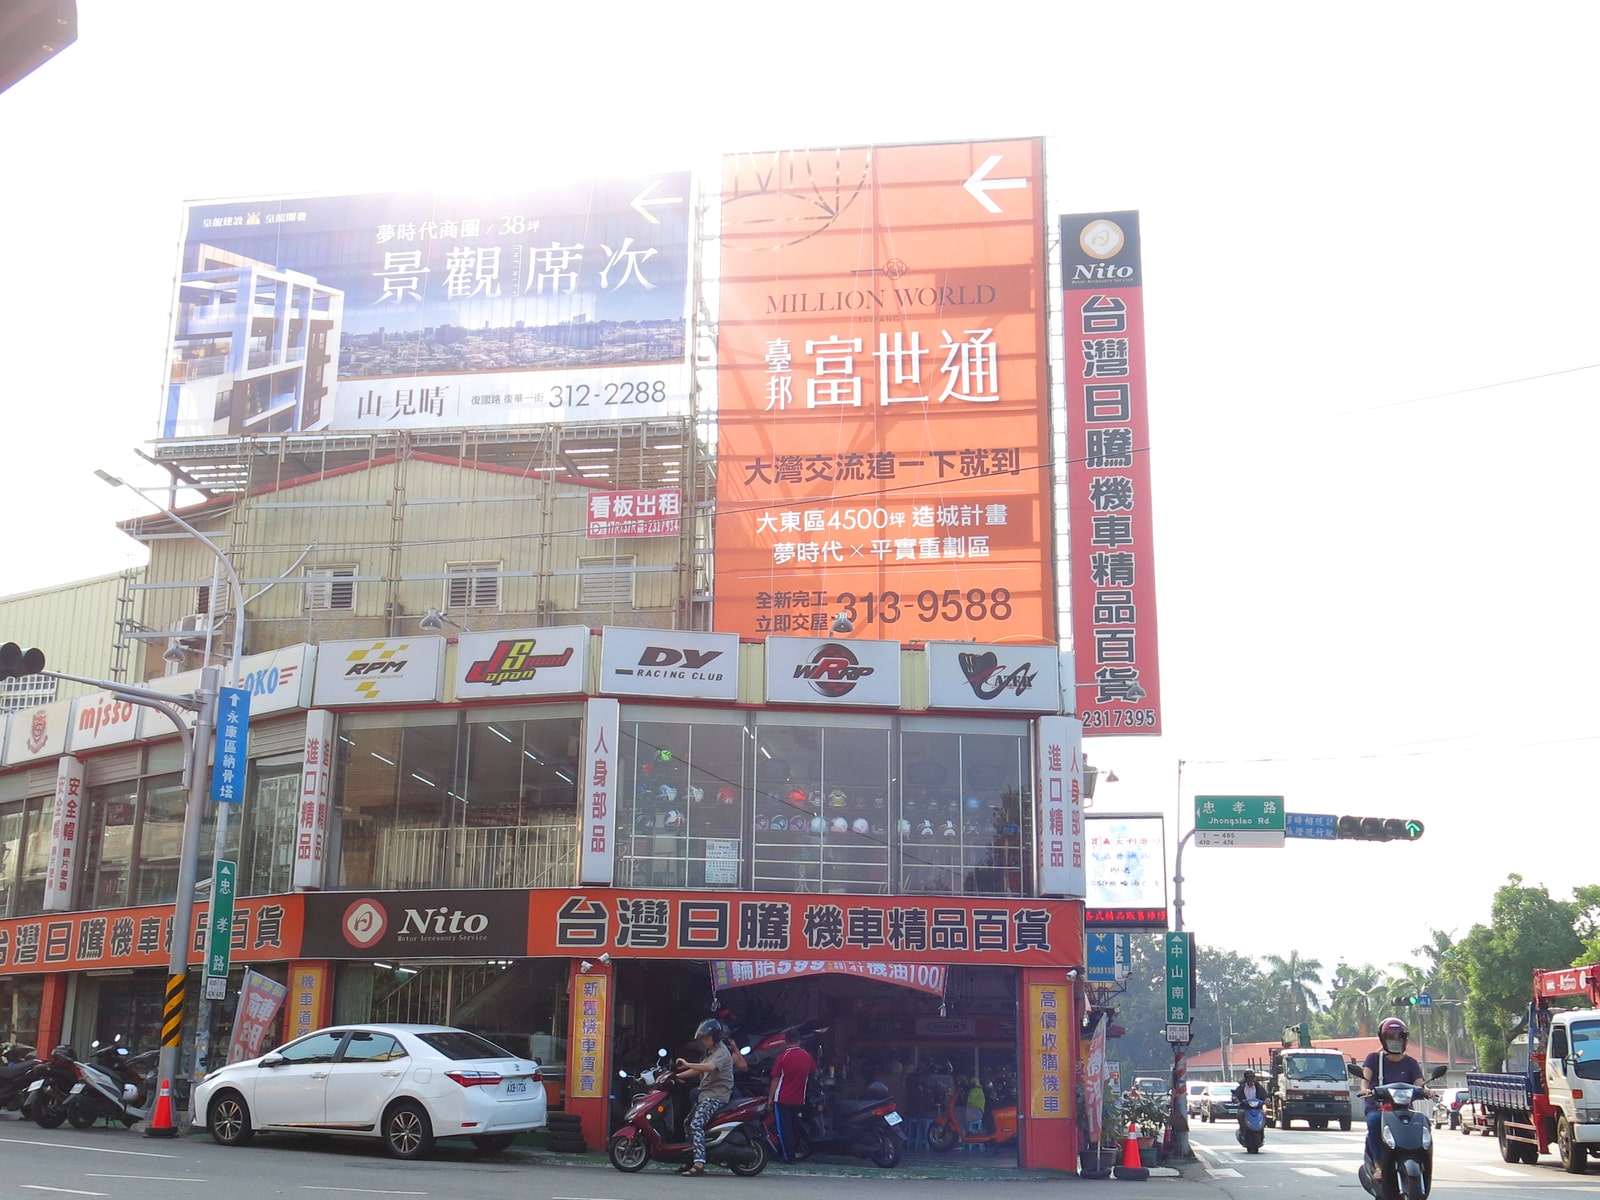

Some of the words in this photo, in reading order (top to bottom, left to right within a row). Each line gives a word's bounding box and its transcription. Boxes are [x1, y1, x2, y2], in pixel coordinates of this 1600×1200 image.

[376, 218, 480, 244] 夢時代商圈
[498, 215, 541, 235] 38坪
[372, 237, 658, 305] 景觀席次
[1071, 262, 1134, 280] Nito
[765, 289, 886, 314] MILLION
[894, 284, 996, 308] WORLD
[764, 337, 792, 411] 臺邦
[804, 327, 999, 409] 富世通
[357, 386, 449, 421] 山見晴
[549, 381, 666, 408] 312-2288
[744, 447, 1020, 486] 大灣交流道一下就到
[590, 493, 680, 519] 看板出租
[1080, 294, 1140, 704] 台灣日騰機車精品百貨
[756, 507, 906, 534] 大東區4500坪
[911, 503, 1008, 528] 造城計畫
[773, 540, 844, 565] 夢時代
[870, 535, 990, 561] 平實重劃區
[755, 590, 828, 610] 全新完工
[835, 588, 1012, 625] 313-9588
[755, 613, 829, 633] 立即交屋
[345, 660, 408, 676] RPM
[637, 646, 724, 669] DY
[636, 668, 686, 679] RACING
[691, 672, 723, 681] CLUB
[1082, 708, 1156, 728] 2317395
[219, 709, 240, 799] 永康區納骨塔
[297, 738, 319, 860] 進口精品
[590, 726, 609, 853] 人身部品
[63, 776, 81, 842] 安全帽
[1048, 743, 1064, 868] 進口精品
[1203, 800, 1277, 815] 忠孝路
[1208, 817, 1253, 826] Jhongsiao
[212, 877, 231, 972] 忠孝路
[397, 906, 489, 934] Nito
[420, 934, 456, 942] Accessory
[1170, 945, 1184, 1021] 中山南路
[579, 981, 600, 1092] 新舊機車買賣
[1040, 990, 1060, 1113] 高價收購機車
